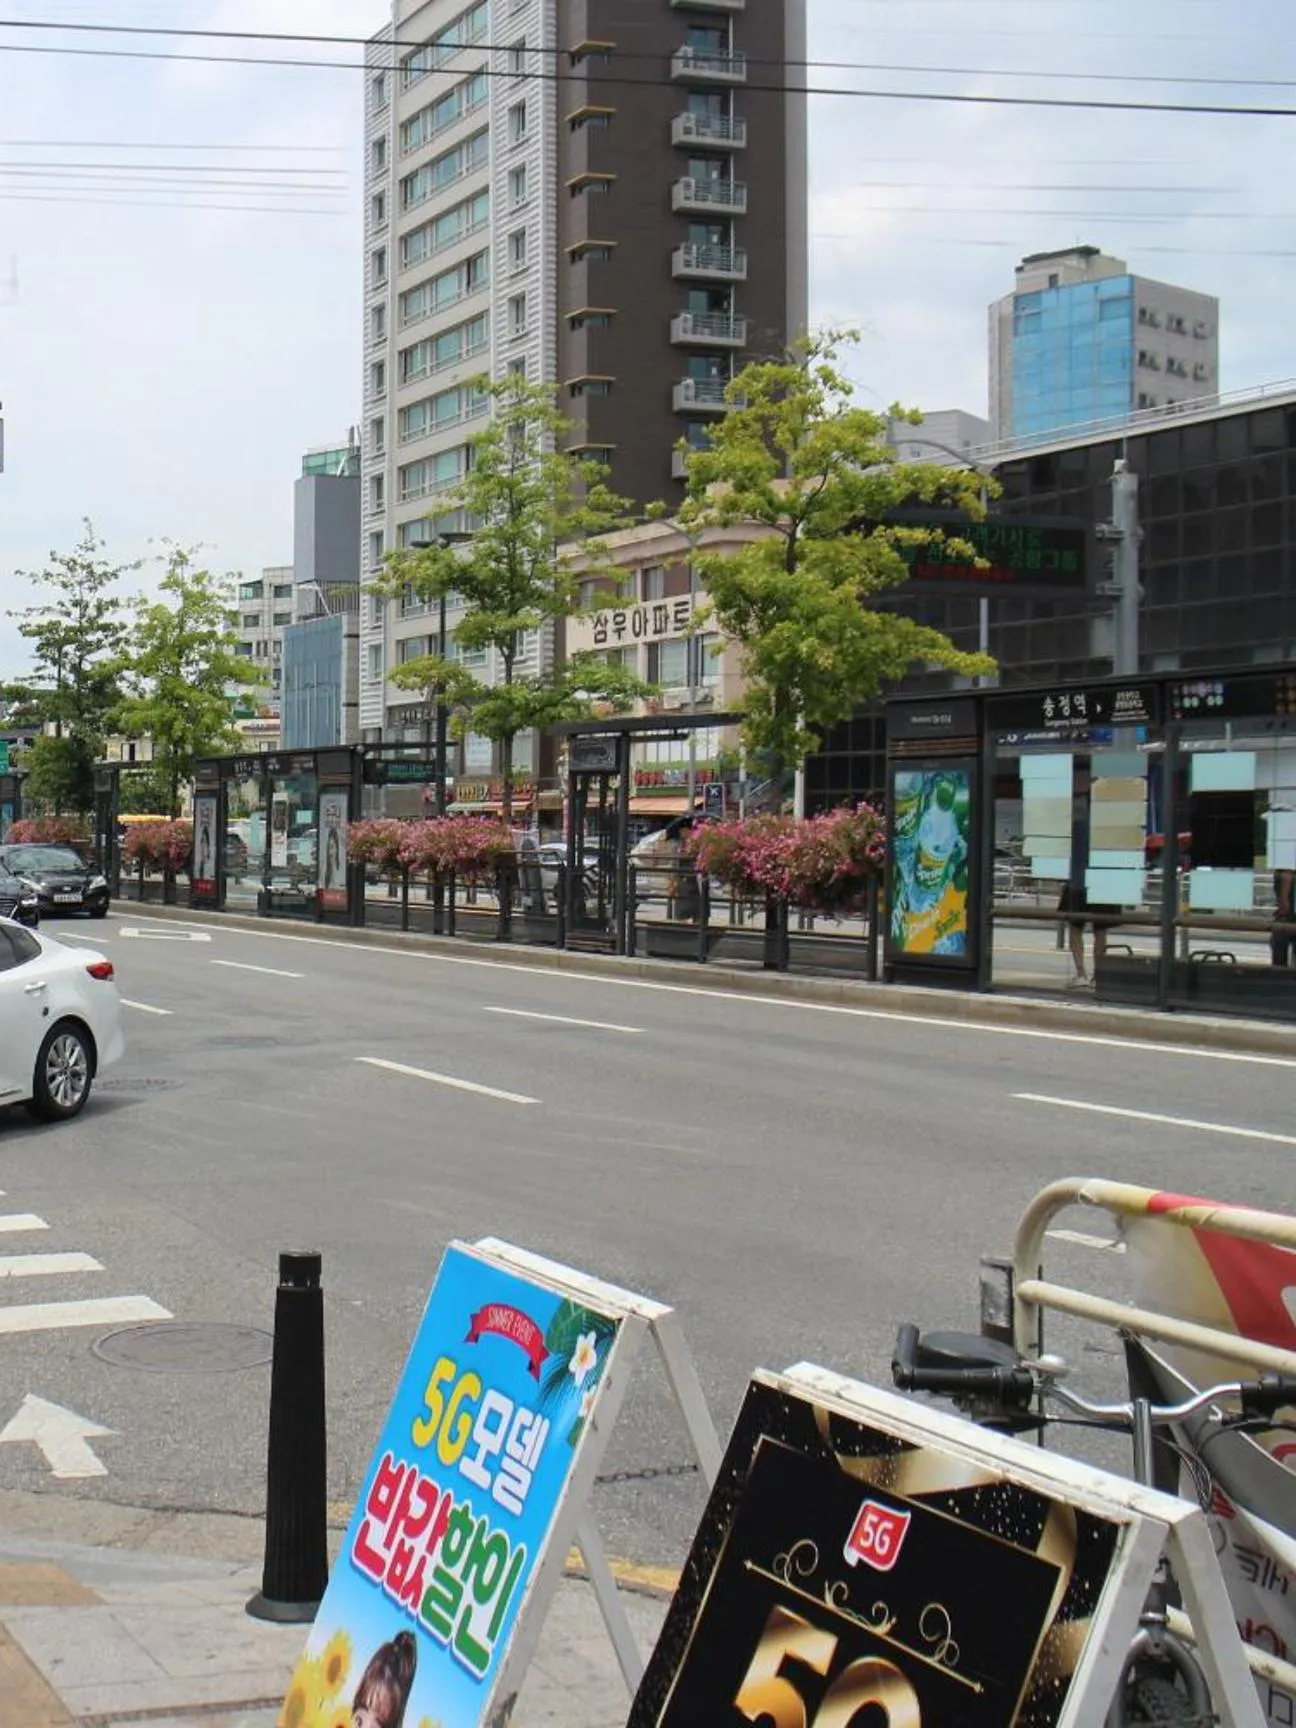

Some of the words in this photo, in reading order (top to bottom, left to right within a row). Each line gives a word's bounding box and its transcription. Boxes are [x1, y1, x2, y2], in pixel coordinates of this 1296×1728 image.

[593, 600, 690, 644] 삼우아파트
[1043, 694, 1086, 718] 송정역
[487, 1306, 515, 1334] SUMMER
[510, 1314, 536, 1347] EVENT
[859, 1511, 895, 1556] 5G
